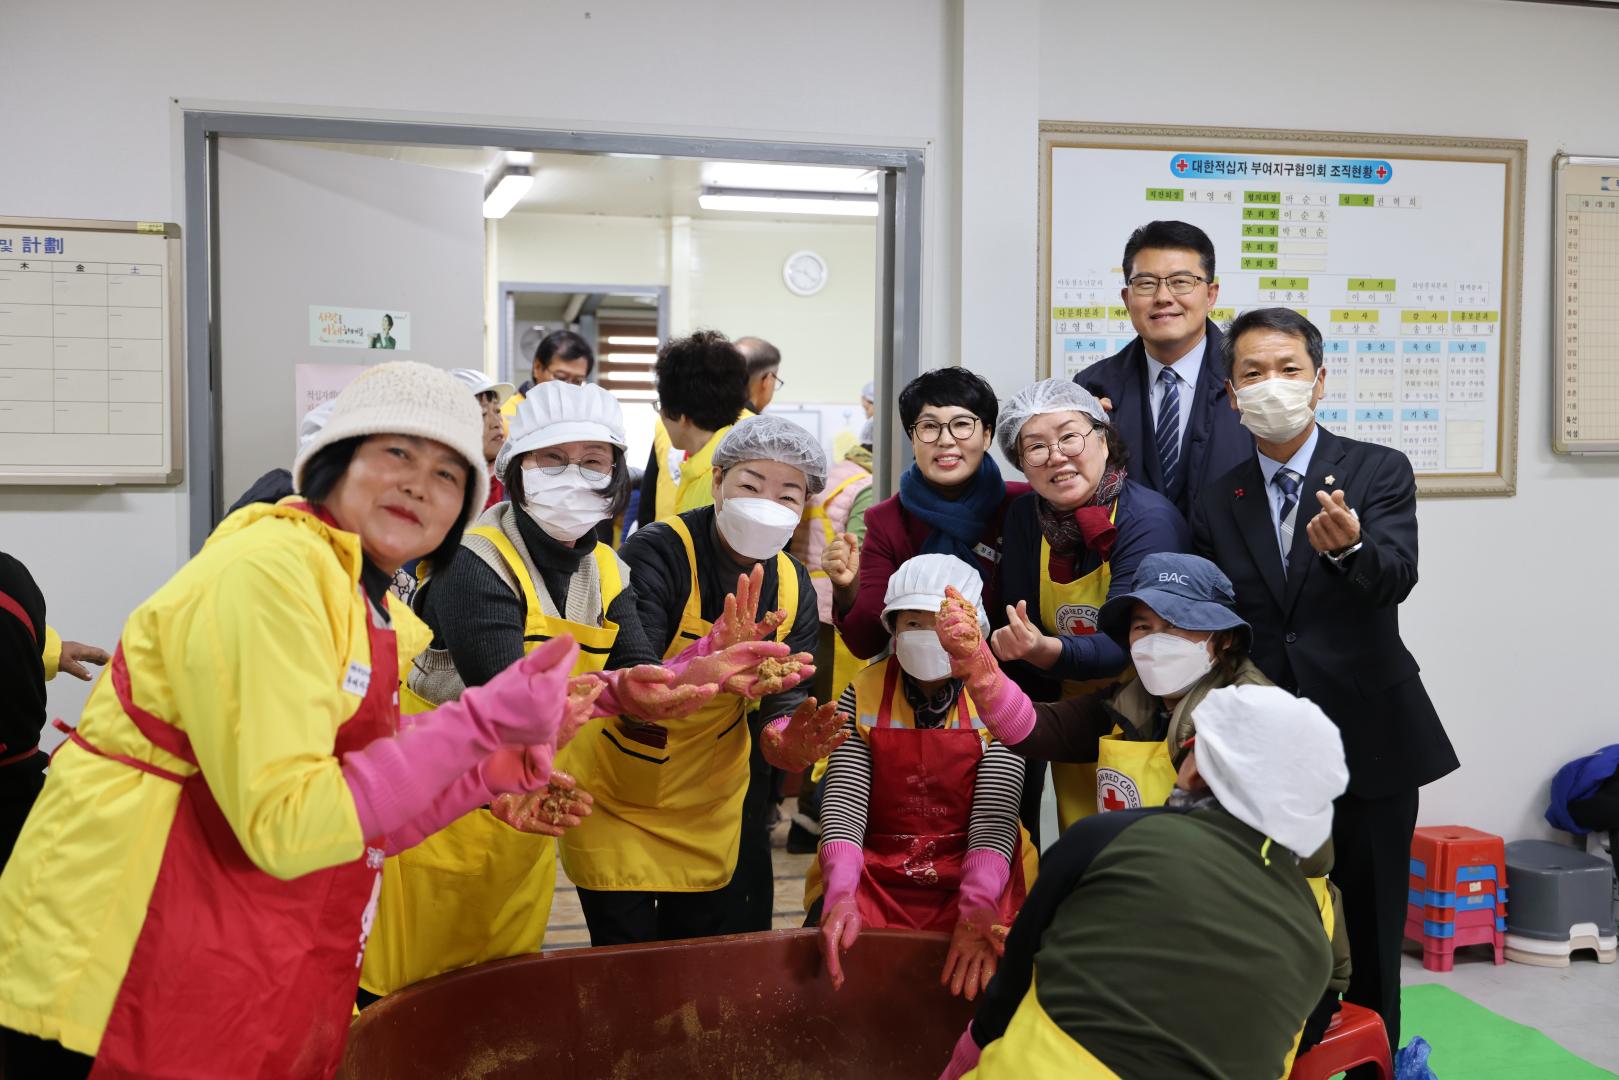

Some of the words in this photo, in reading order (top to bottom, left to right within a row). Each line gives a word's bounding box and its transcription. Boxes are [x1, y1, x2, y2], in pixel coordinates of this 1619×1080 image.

[1192, 160, 1247, 175] 대한적십자
[1251, 161, 1326, 178] 부여지구협의회
[1330, 164, 1373, 179] 조직현황
[1246, 209, 1276, 219] 부회장
[1246, 226, 1275, 236] 부회장
[22, 236, 64, 255] 計劃
[20, 261, 30, 270] 木
[76, 263, 85, 272] 金
[131, 266, 140, 274] 土
[1058, 307, 1099, 318] 다문화분과
[1158, 572, 1190, 586] BAC
[1105, 772, 1119, 783] RED
[1119, 780, 1138, 809] CROSS
